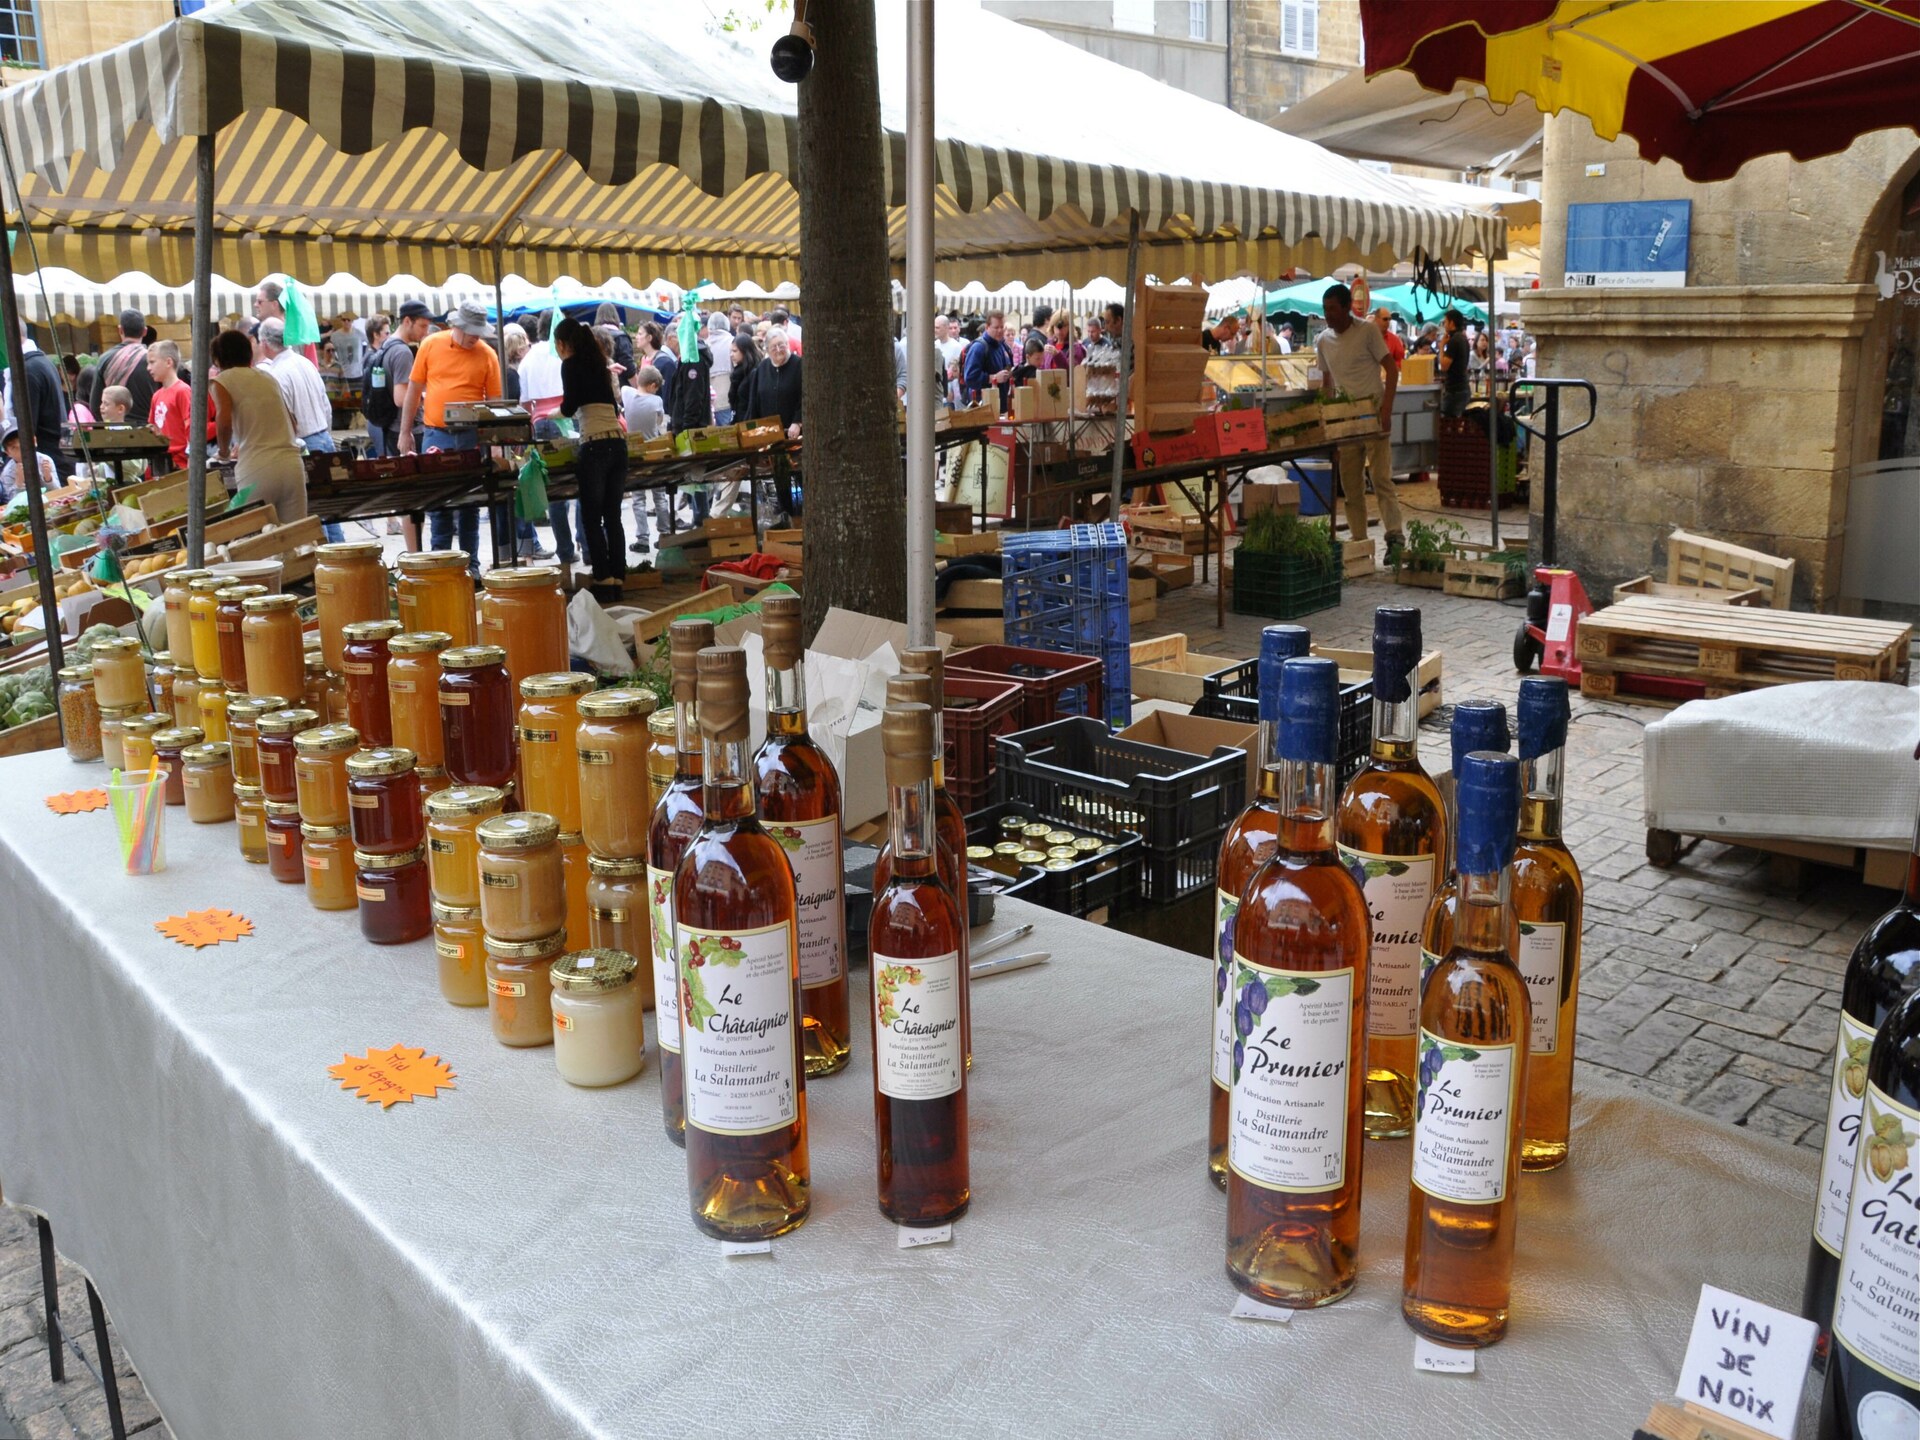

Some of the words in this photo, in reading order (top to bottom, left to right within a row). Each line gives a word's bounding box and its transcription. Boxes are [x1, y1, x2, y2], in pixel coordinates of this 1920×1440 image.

[797, 888, 836, 910] taignier
[800, 935, 831, 950] mandre
[1377, 961, 1411, 969] Artisanale
[1523, 974, 1555, 986] nier
[719, 984, 743, 1005] Le
[1372, 985, 1413, 997] mandre
[901, 997, 920, 1014] Le
[1299, 1002, 1323, 1011] Apéritif
[1323, 1000, 1344, 1009] Maison
[708, 1011, 789, 1038] Châtaignier
[893, 1018, 956, 1038] Châtaignier
[1319, 1017, 1340, 1026] prunes
[725, 1035, 752, 1043] gourmet
[1261, 1026, 1291, 1050] Le
[699, 1045, 737, 1056] Fabrication
[740, 1045, 775, 1056] Artisanale
[889, 1042, 919, 1051] Fabrication
[920, 1042, 947, 1051] Artisanale
[888, 1058, 897, 1067] La
[900, 1057, 950, 1070] Salamandre
[900, 1052, 936, 1061] Distillerie
[1247, 1046, 1344, 1078] Prunier
[714, 1063, 757, 1073] Distillerie
[695, 1069, 706, 1082] La
[710, 1071, 780, 1086] Salamandre
[1260, 1073, 1268, 1081] du
[1270, 1078, 1298, 1088] gourmet
[750, 1087, 776, 1098] SARLAT
[1243, 1086, 1281, 1105] Fabrication
[1284, 1099, 1325, 1108] Artisanale
[1439, 1080, 1461, 1098] Le
[778, 1094, 785, 1107] 16
[1428, 1093, 1502, 1121] Prunier
[1237, 1110, 1248, 1127] La
[1251, 1118, 1328, 1140] Salamandre
[1256, 1109, 1302, 1126] Distillerie
[1424, 1125, 1454, 1141] Fabrication
[1456, 1137, 1489, 1145] Artisanale
[1270, 1143, 1291, 1153] 24200
[1292, 1145, 1322, 1154] SARLAT
[1419, 1141, 1428, 1154] La
[1431, 1148, 1495, 1167] Salamandre
[1434, 1141, 1474, 1157] Distillerie
[1324, 1154, 1332, 1168] 17
[1333, 1152, 1340, 1164] %
[1829, 1180, 1842, 1199] La
[1880, 1234, 1891, 1245] du
[1859, 1243, 1909, 1278] Fabrication
[1849, 1269, 1863, 1291] La
[1890, 1322, 1918, 1339] 24200
[1424, 1357, 1456, 1368] 8,50
[1717, 1347, 1756, 1376] DE
